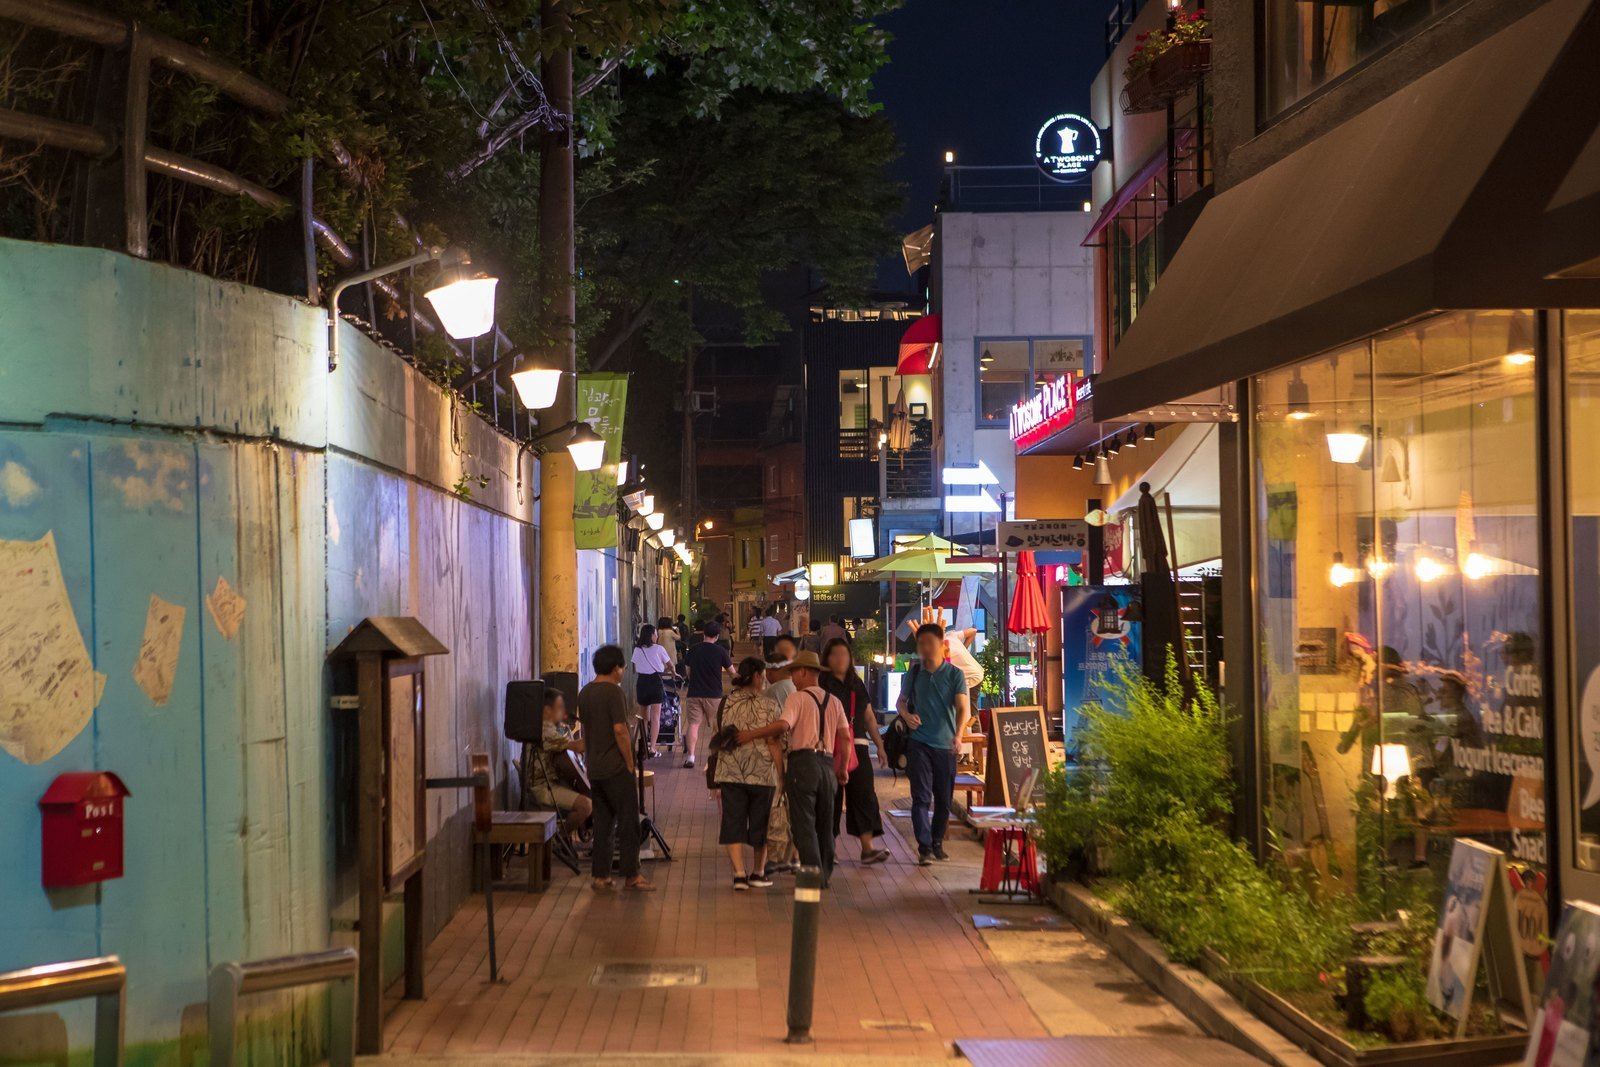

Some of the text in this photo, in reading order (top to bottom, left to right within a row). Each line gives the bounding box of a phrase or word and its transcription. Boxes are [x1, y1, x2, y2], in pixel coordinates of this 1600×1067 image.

[1042, 375, 1067, 420] PLACE
[1503, 705, 1515, 737] &
[1516, 706, 1543, 740] Cak
[1012, 741, 1029, 755] 우동
[1450, 737, 1492, 777] Yogurt
[85, 802, 114, 819] Post
[1512, 827, 1547, 865] Snac
